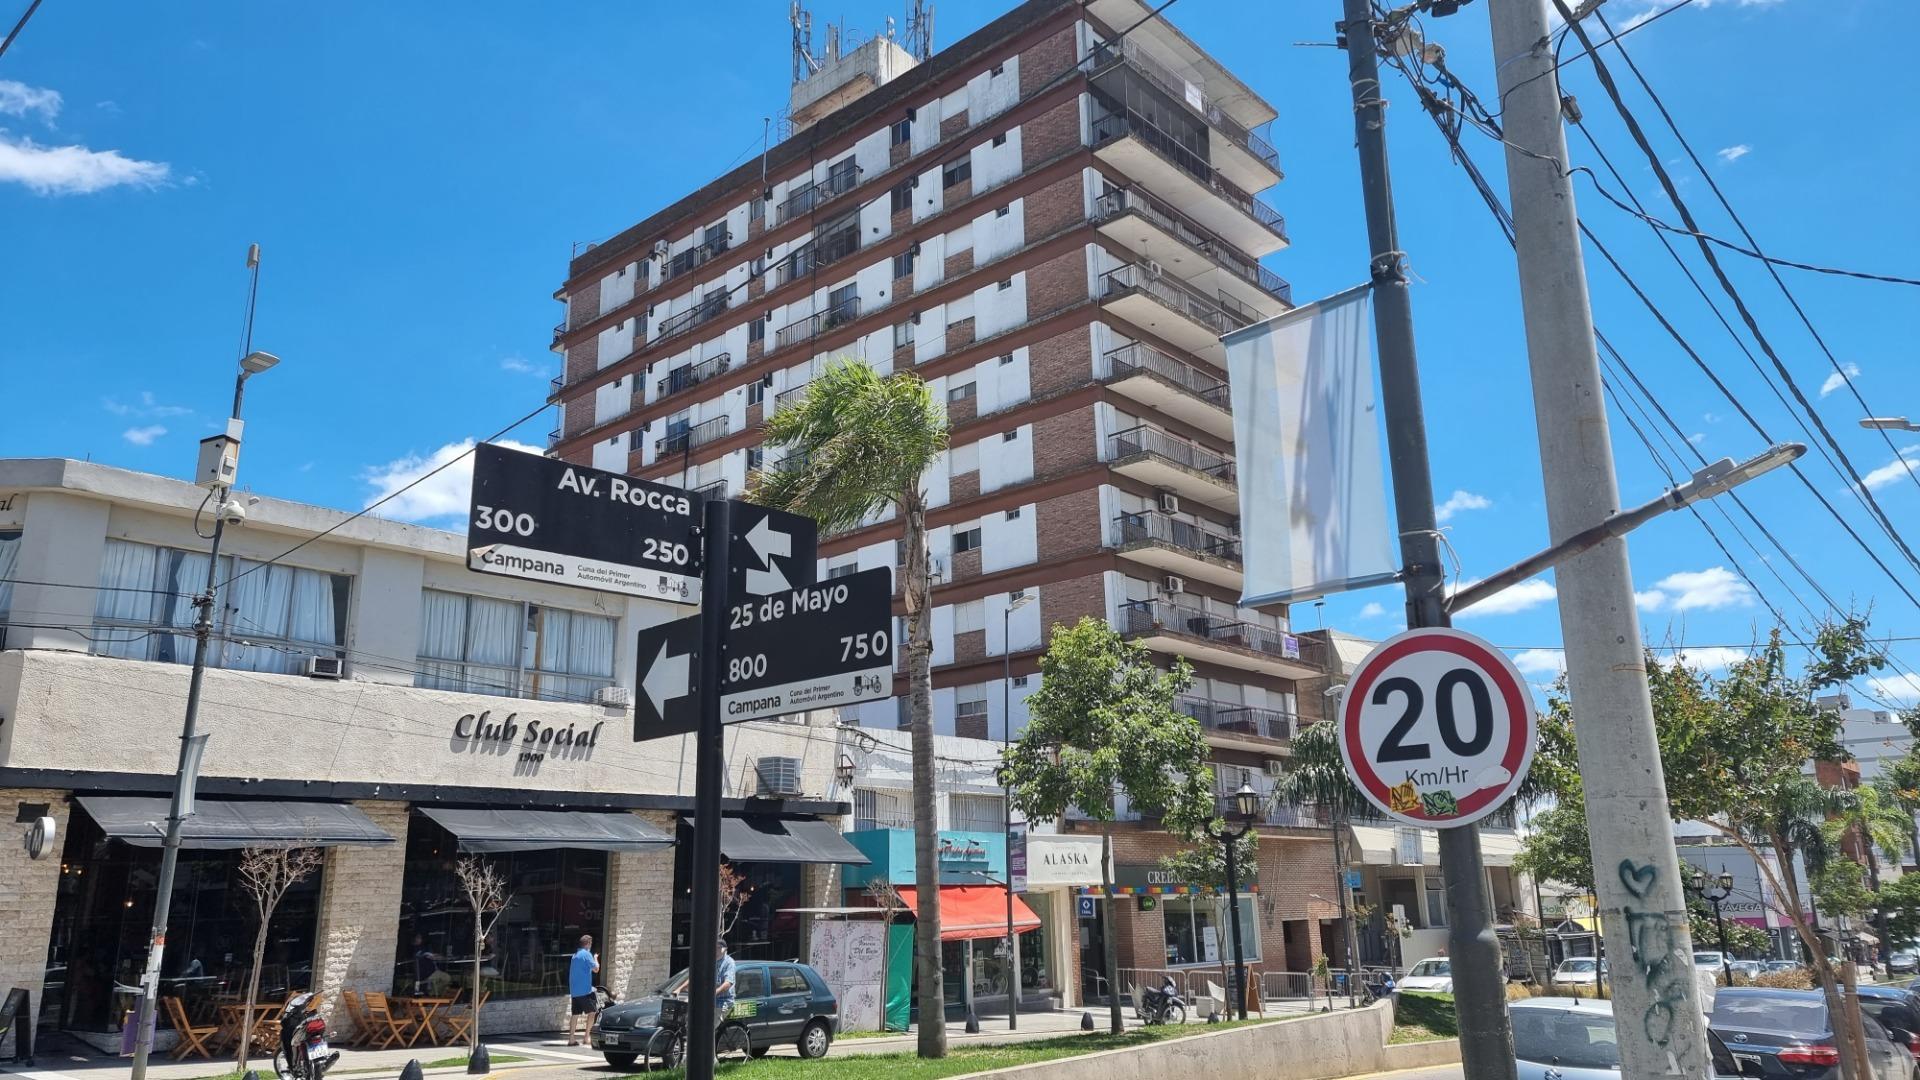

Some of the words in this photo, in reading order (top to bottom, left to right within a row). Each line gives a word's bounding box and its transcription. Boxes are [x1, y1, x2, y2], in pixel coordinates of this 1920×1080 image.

[558, 467, 600, 497] Av.
[610, 478, 690, 516] Rocca
[474, 505, 535, 536] 300
[481, 549, 565, 576] Campana
[642, 538, 689, 566] 250
[577, 564, 595, 573] Cuna
[596, 567, 608, 575] del
[609, 569, 631, 579] Primer
[577, 572, 613, 583] Automóvil
[614, 578, 647, 589] Argentino
[730, 603, 753, 630] 25
[759, 597, 785, 622] de
[792, 584, 849, 615] Mayo
[840, 630, 888, 662] 750
[729, 653, 767, 682] 800
[728, 695, 781, 715] Campana
[1372, 668, 1494, 763] 20
[454, 710, 518, 741] Club
[523, 719, 605, 748] Social
[518, 752, 545, 763] 1900
[1405, 765, 1469, 786] Km/Hr
[1043, 852, 1088, 865] ALASKA
